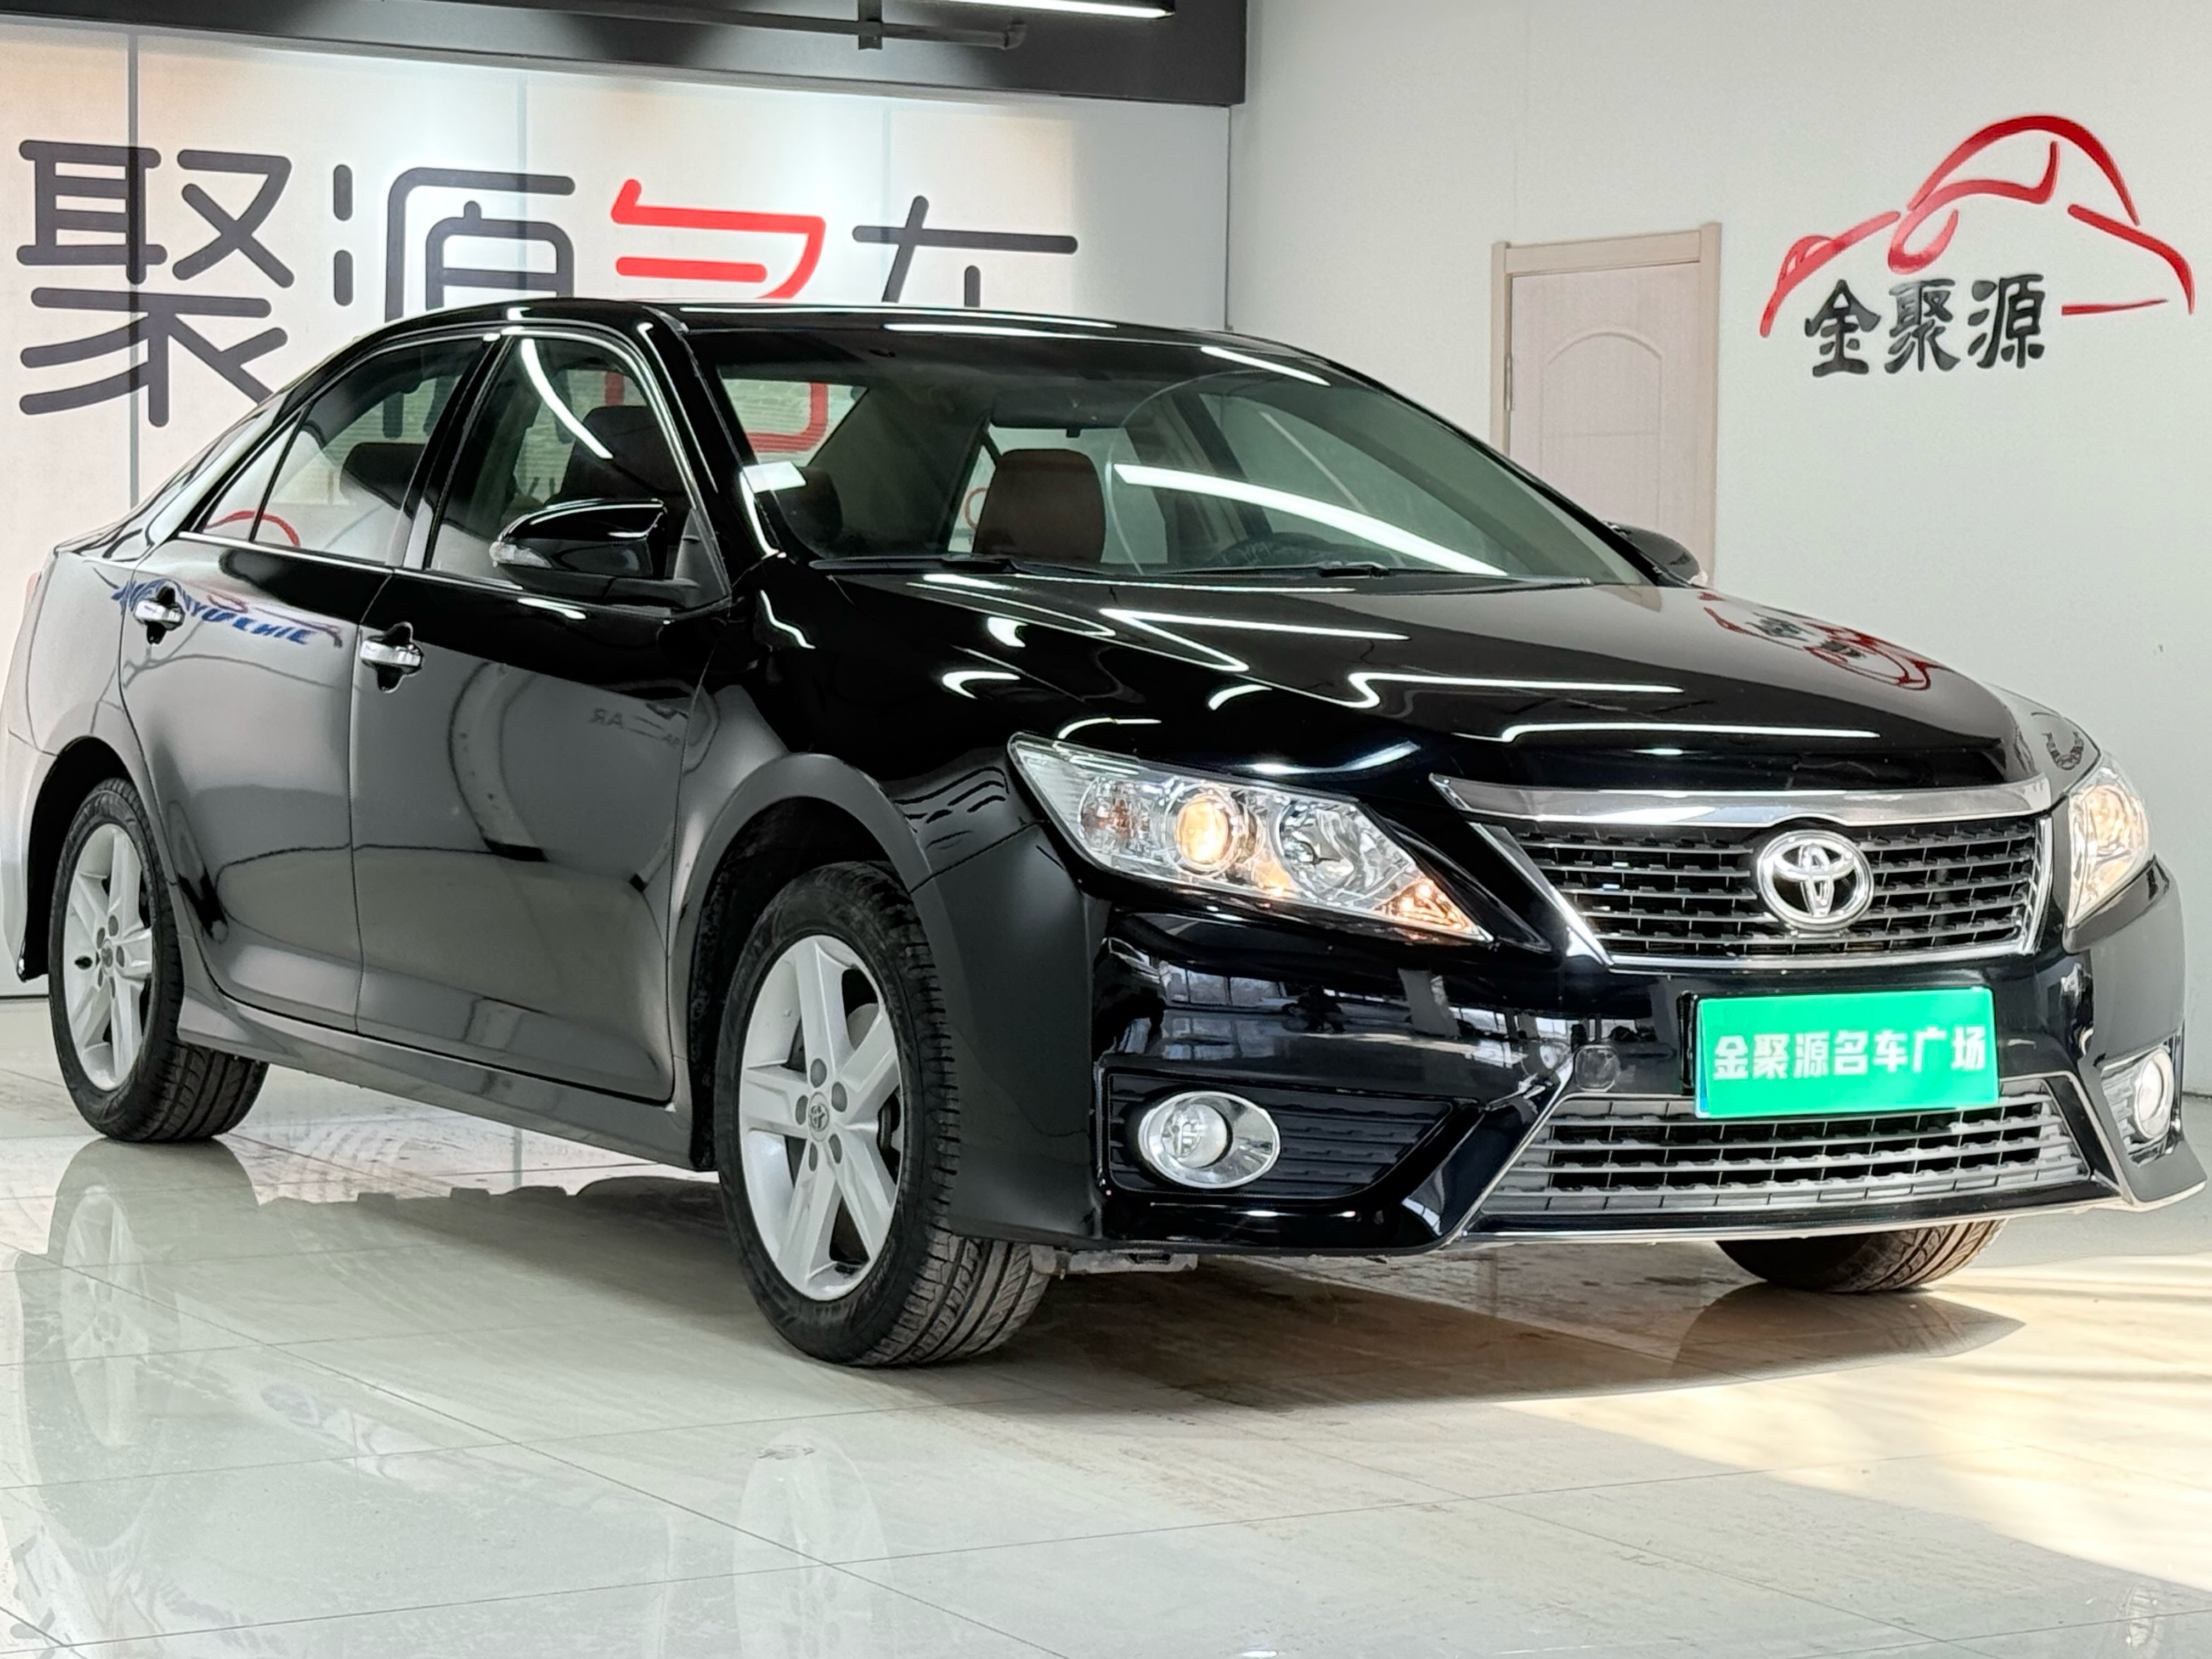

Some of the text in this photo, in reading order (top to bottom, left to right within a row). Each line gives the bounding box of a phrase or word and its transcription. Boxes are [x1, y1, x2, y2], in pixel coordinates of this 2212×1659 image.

[1804, 273, 2046, 378] 金聚源
[1712, 1024, 1987, 1081] 金聚源名车广场
